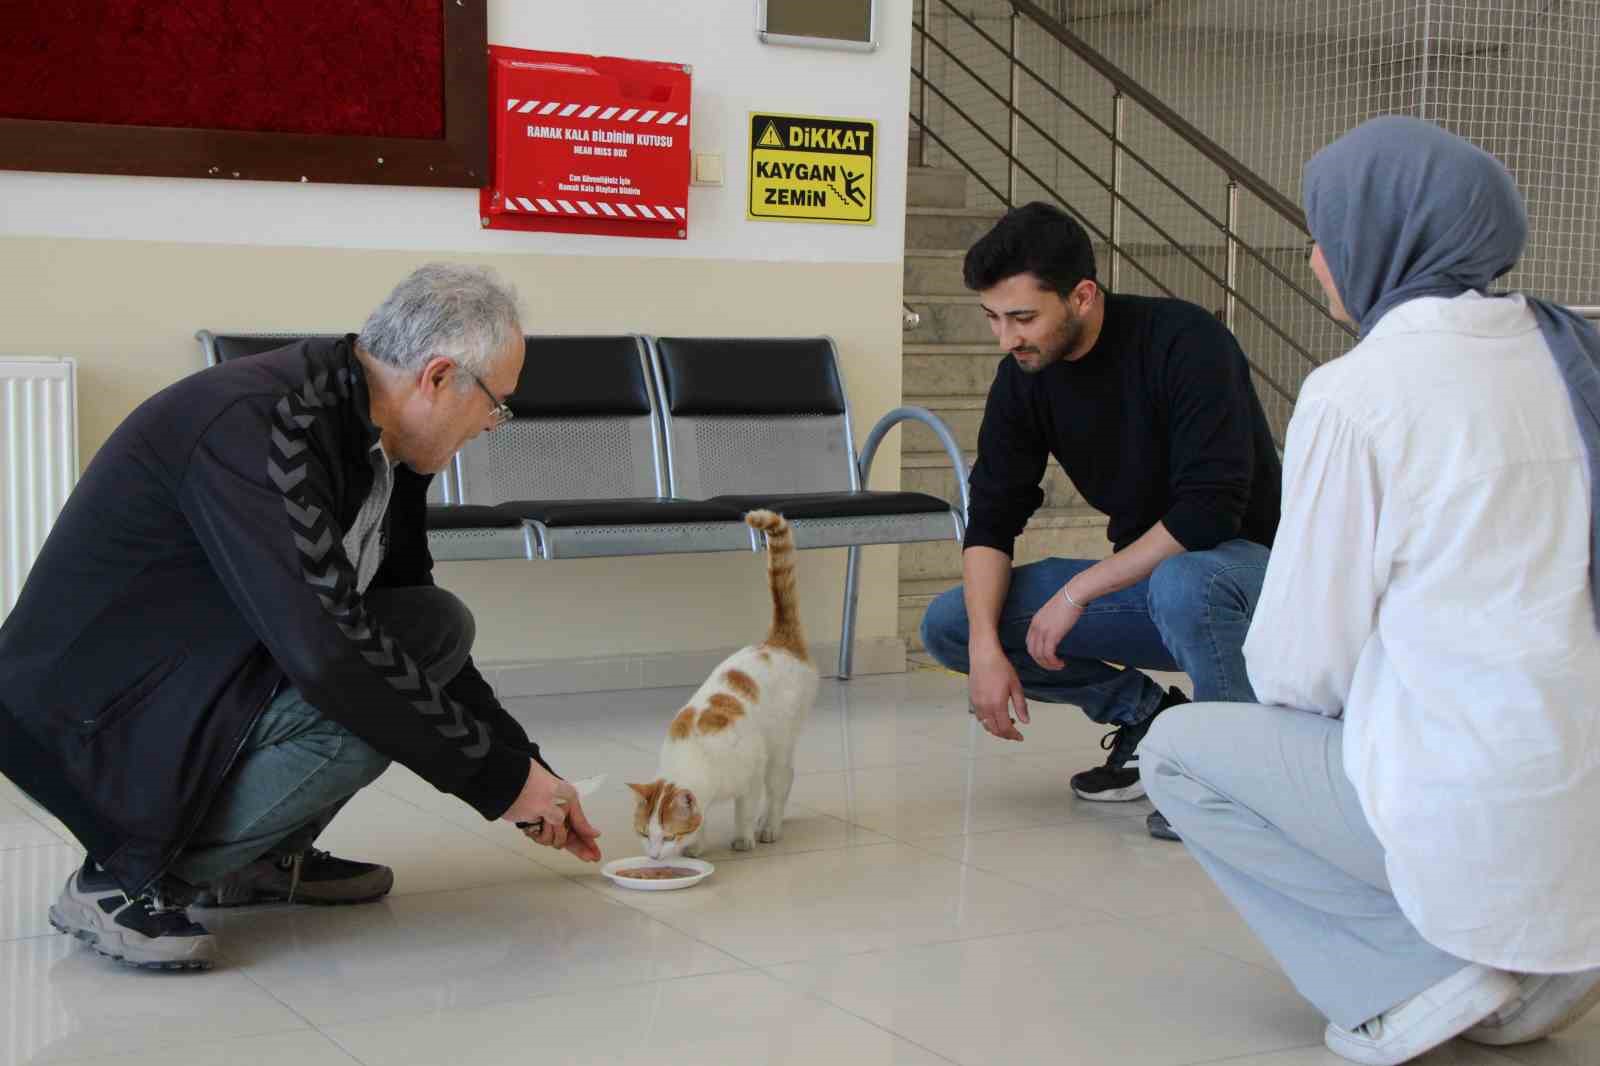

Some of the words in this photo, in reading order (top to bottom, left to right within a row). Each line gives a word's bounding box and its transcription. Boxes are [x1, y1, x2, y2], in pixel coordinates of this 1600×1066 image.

[527, 126, 562, 139] RAMAK
[565, 129, 590, 141] KALA
[636, 134, 673, 148] KUTUSU
[574, 145, 593, 155] NEAR
[613, 148, 628, 158] BOX
[756, 161, 836, 181] KAYGAN
